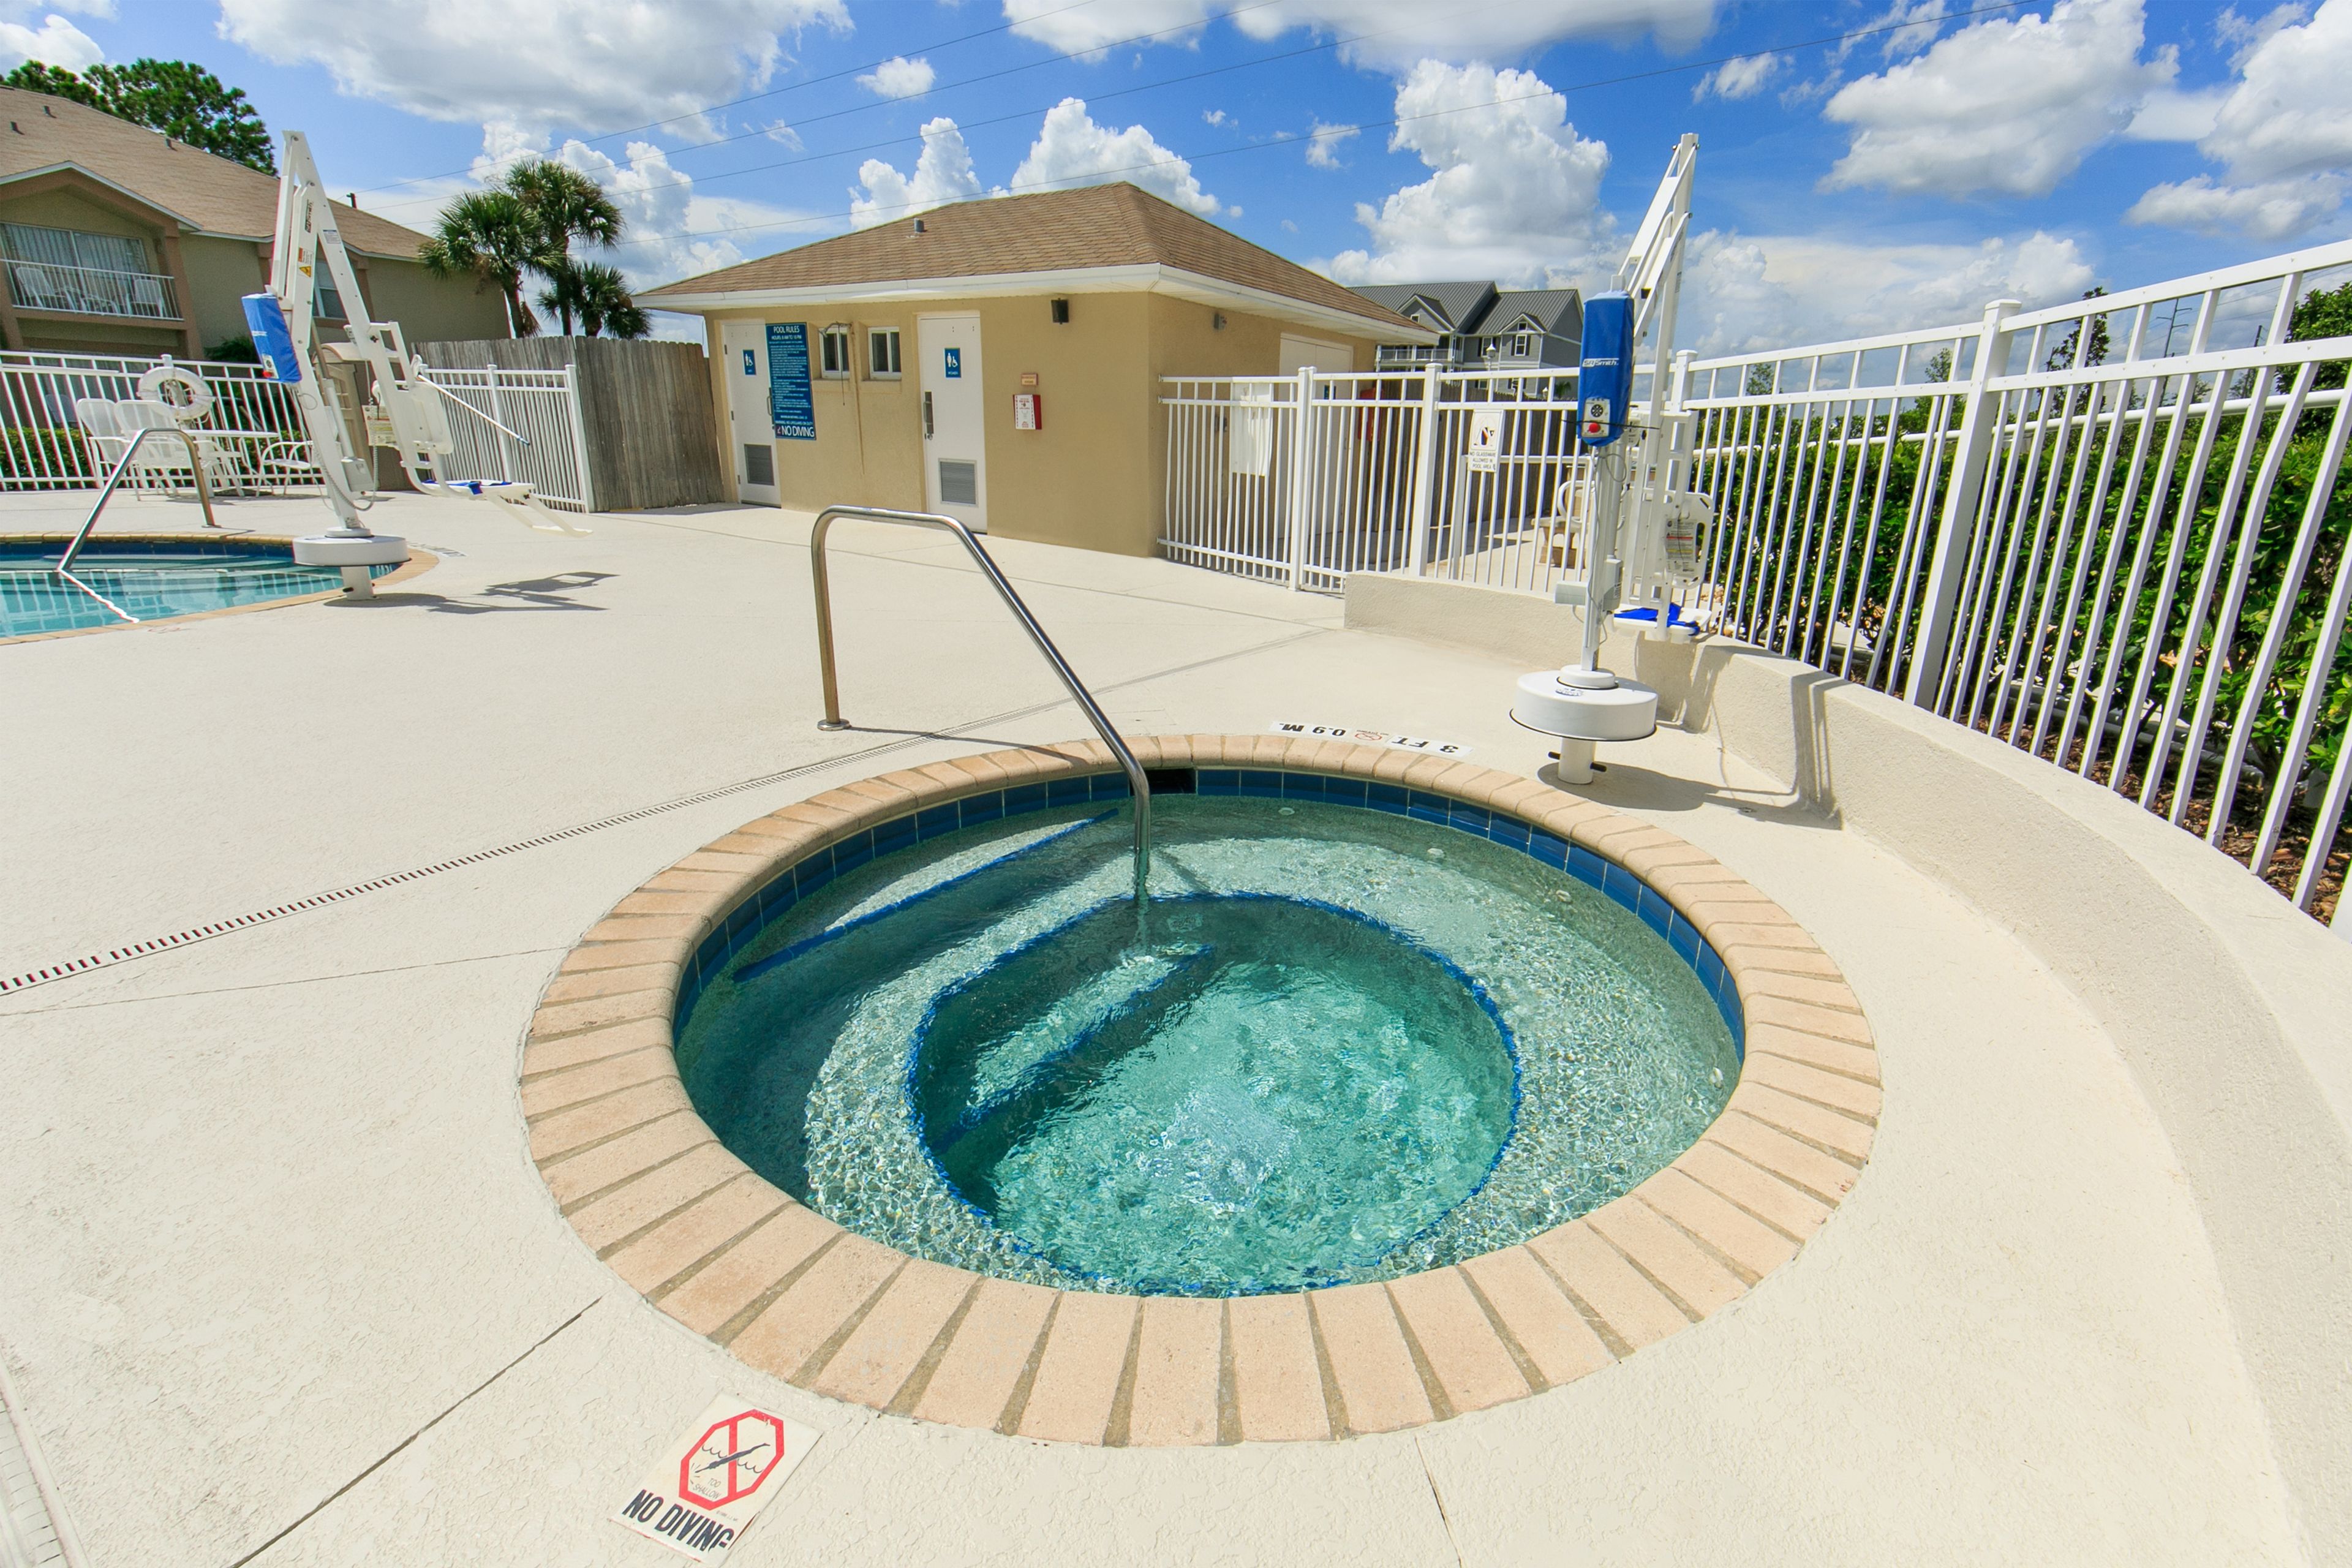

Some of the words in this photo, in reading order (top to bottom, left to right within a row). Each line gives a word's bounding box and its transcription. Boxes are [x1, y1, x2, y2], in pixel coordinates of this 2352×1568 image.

[782, 426, 792, 436] NO
[792, 426, 815, 437] DIVING
[707, 1477, 722, 1488] TOO
[692, 1483, 722, 1499] SHALLOW
[622, 1489, 664, 1523] NO
